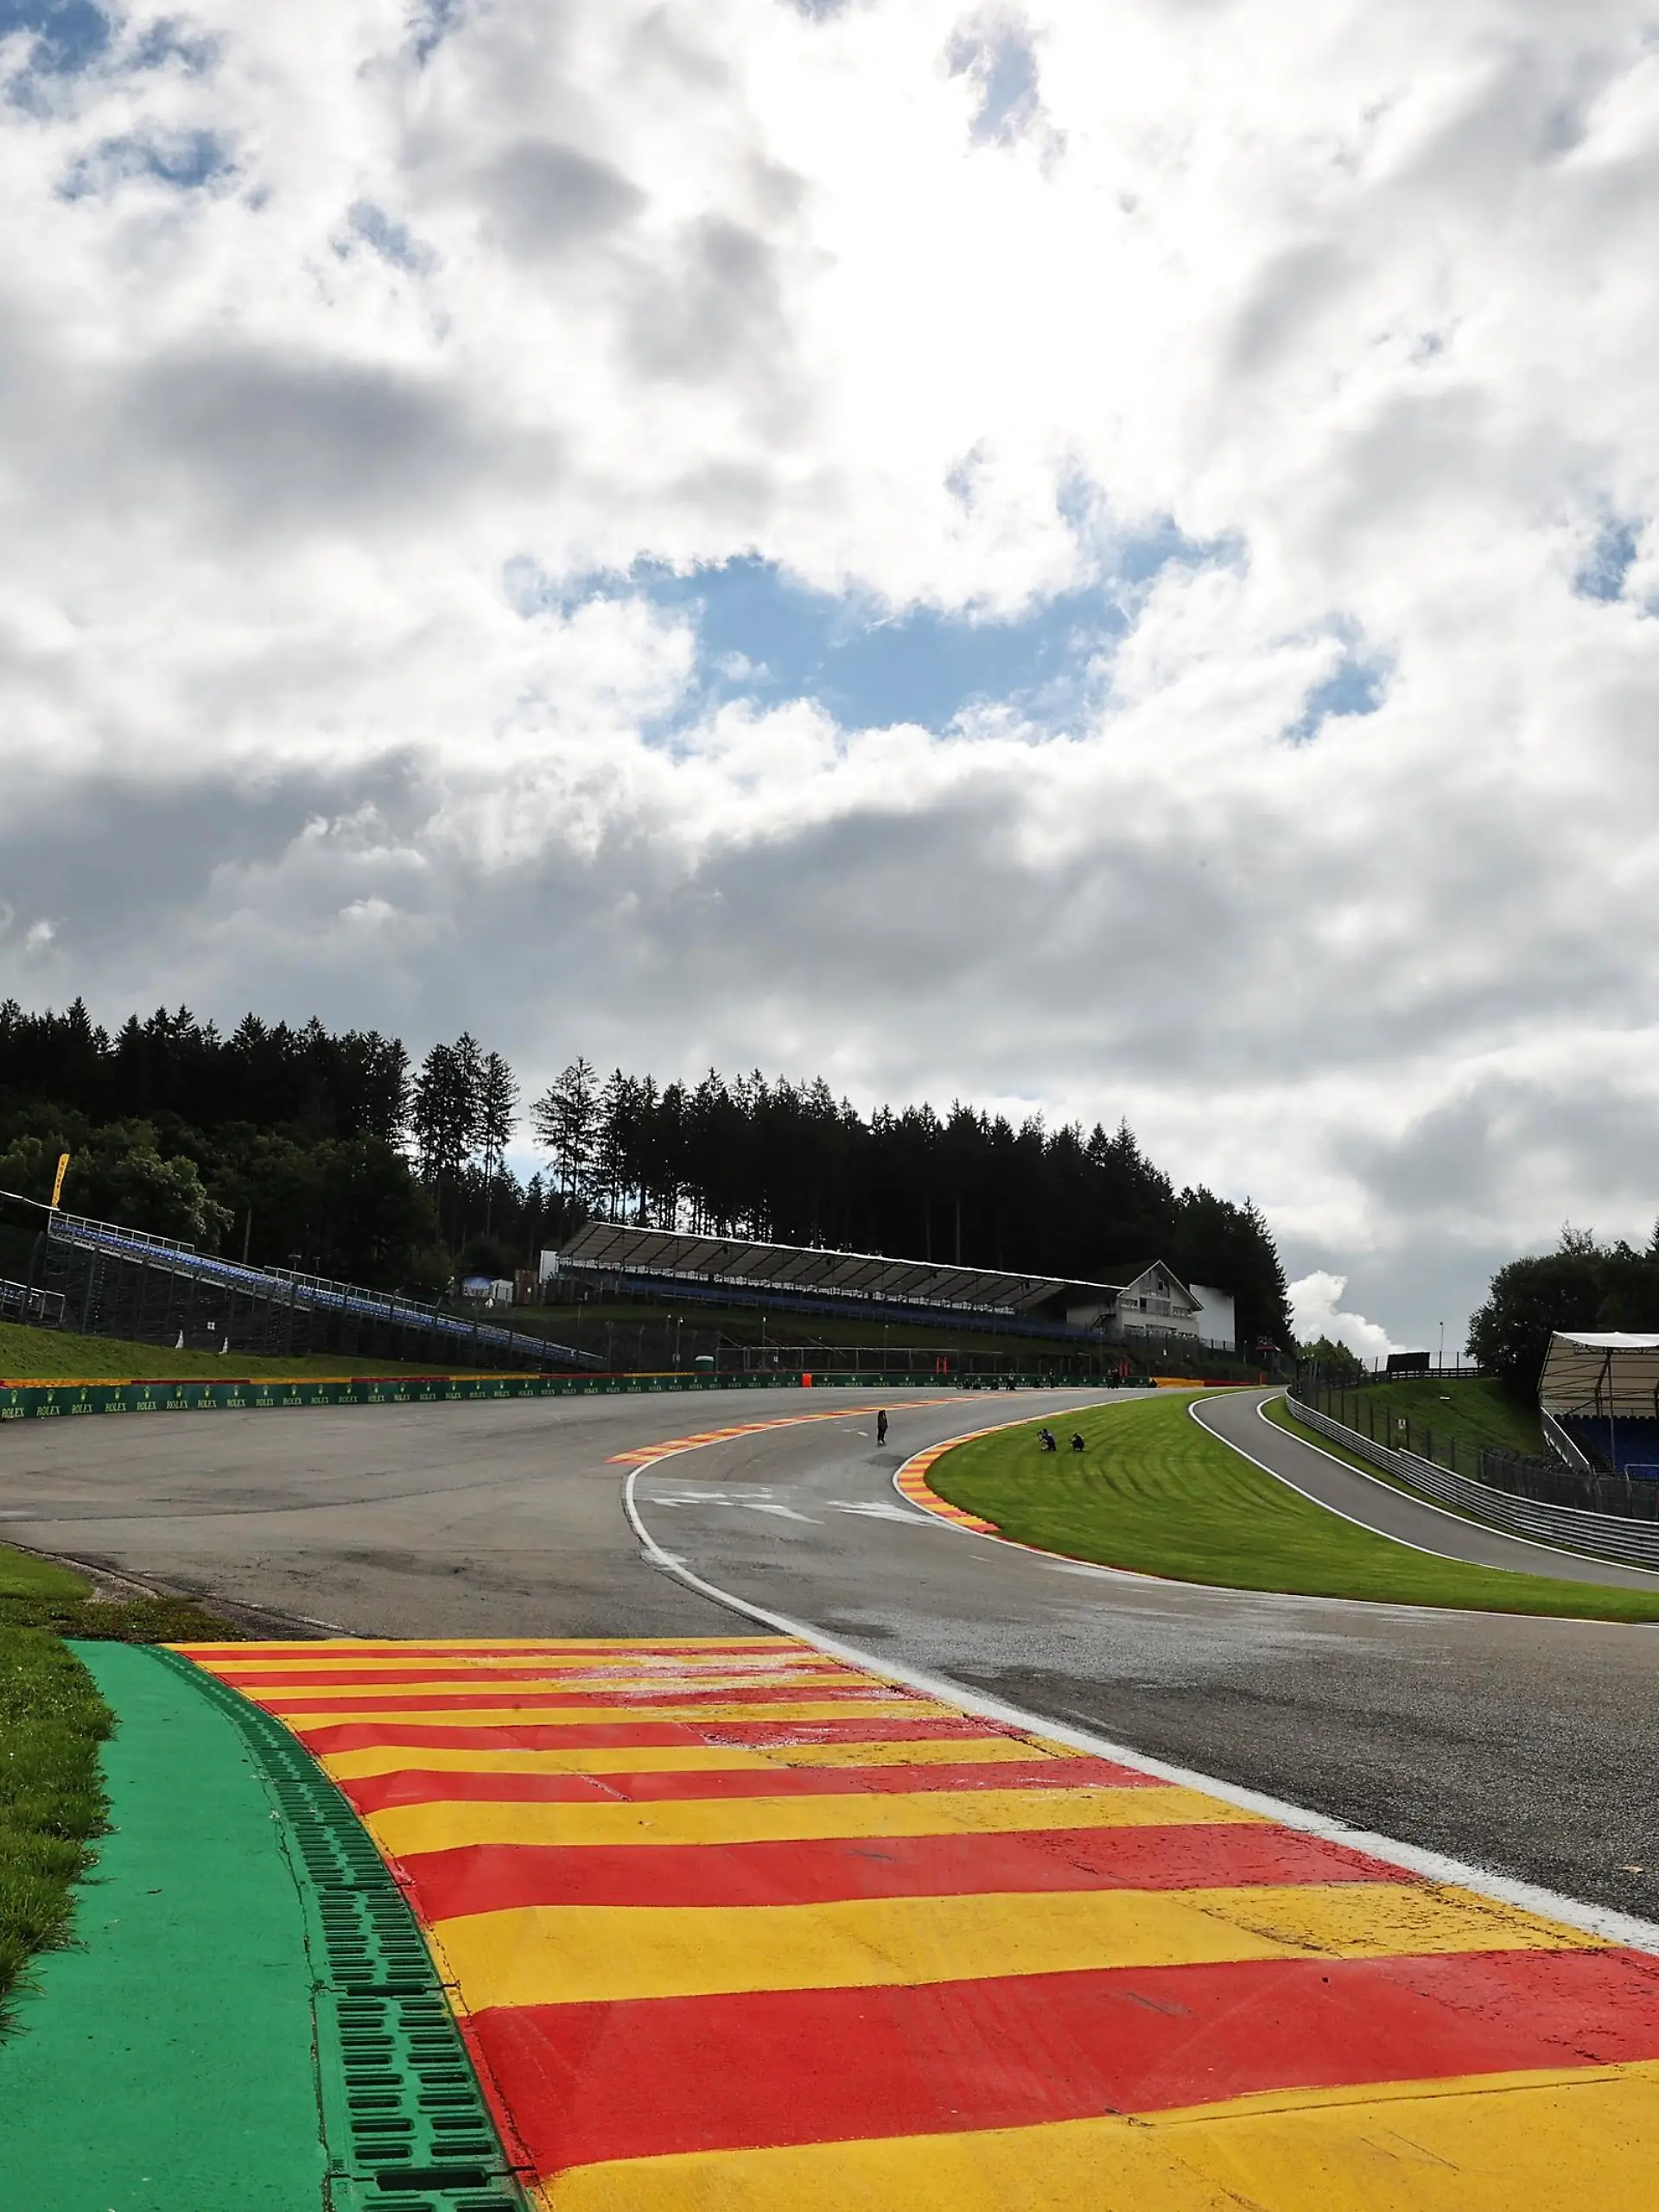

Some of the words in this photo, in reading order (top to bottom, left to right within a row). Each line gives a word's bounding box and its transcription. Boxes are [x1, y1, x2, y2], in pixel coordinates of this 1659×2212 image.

[137, 1402, 156, 1410] ROLEX
[166, 1400, 188, 1409] ROLEX
[197, 1399, 217, 1408] ROLEX
[226, 1399, 245, 1408] ROLEX
[283, 1397, 302, 1406] ROLEX
[36, 1405, 60, 1416] ROLEX
[73, 1403, 92, 1414] ROLEX
[105, 1402, 126, 1412] ROLEX
[2, 1408, 24, 1418] ROLEX
